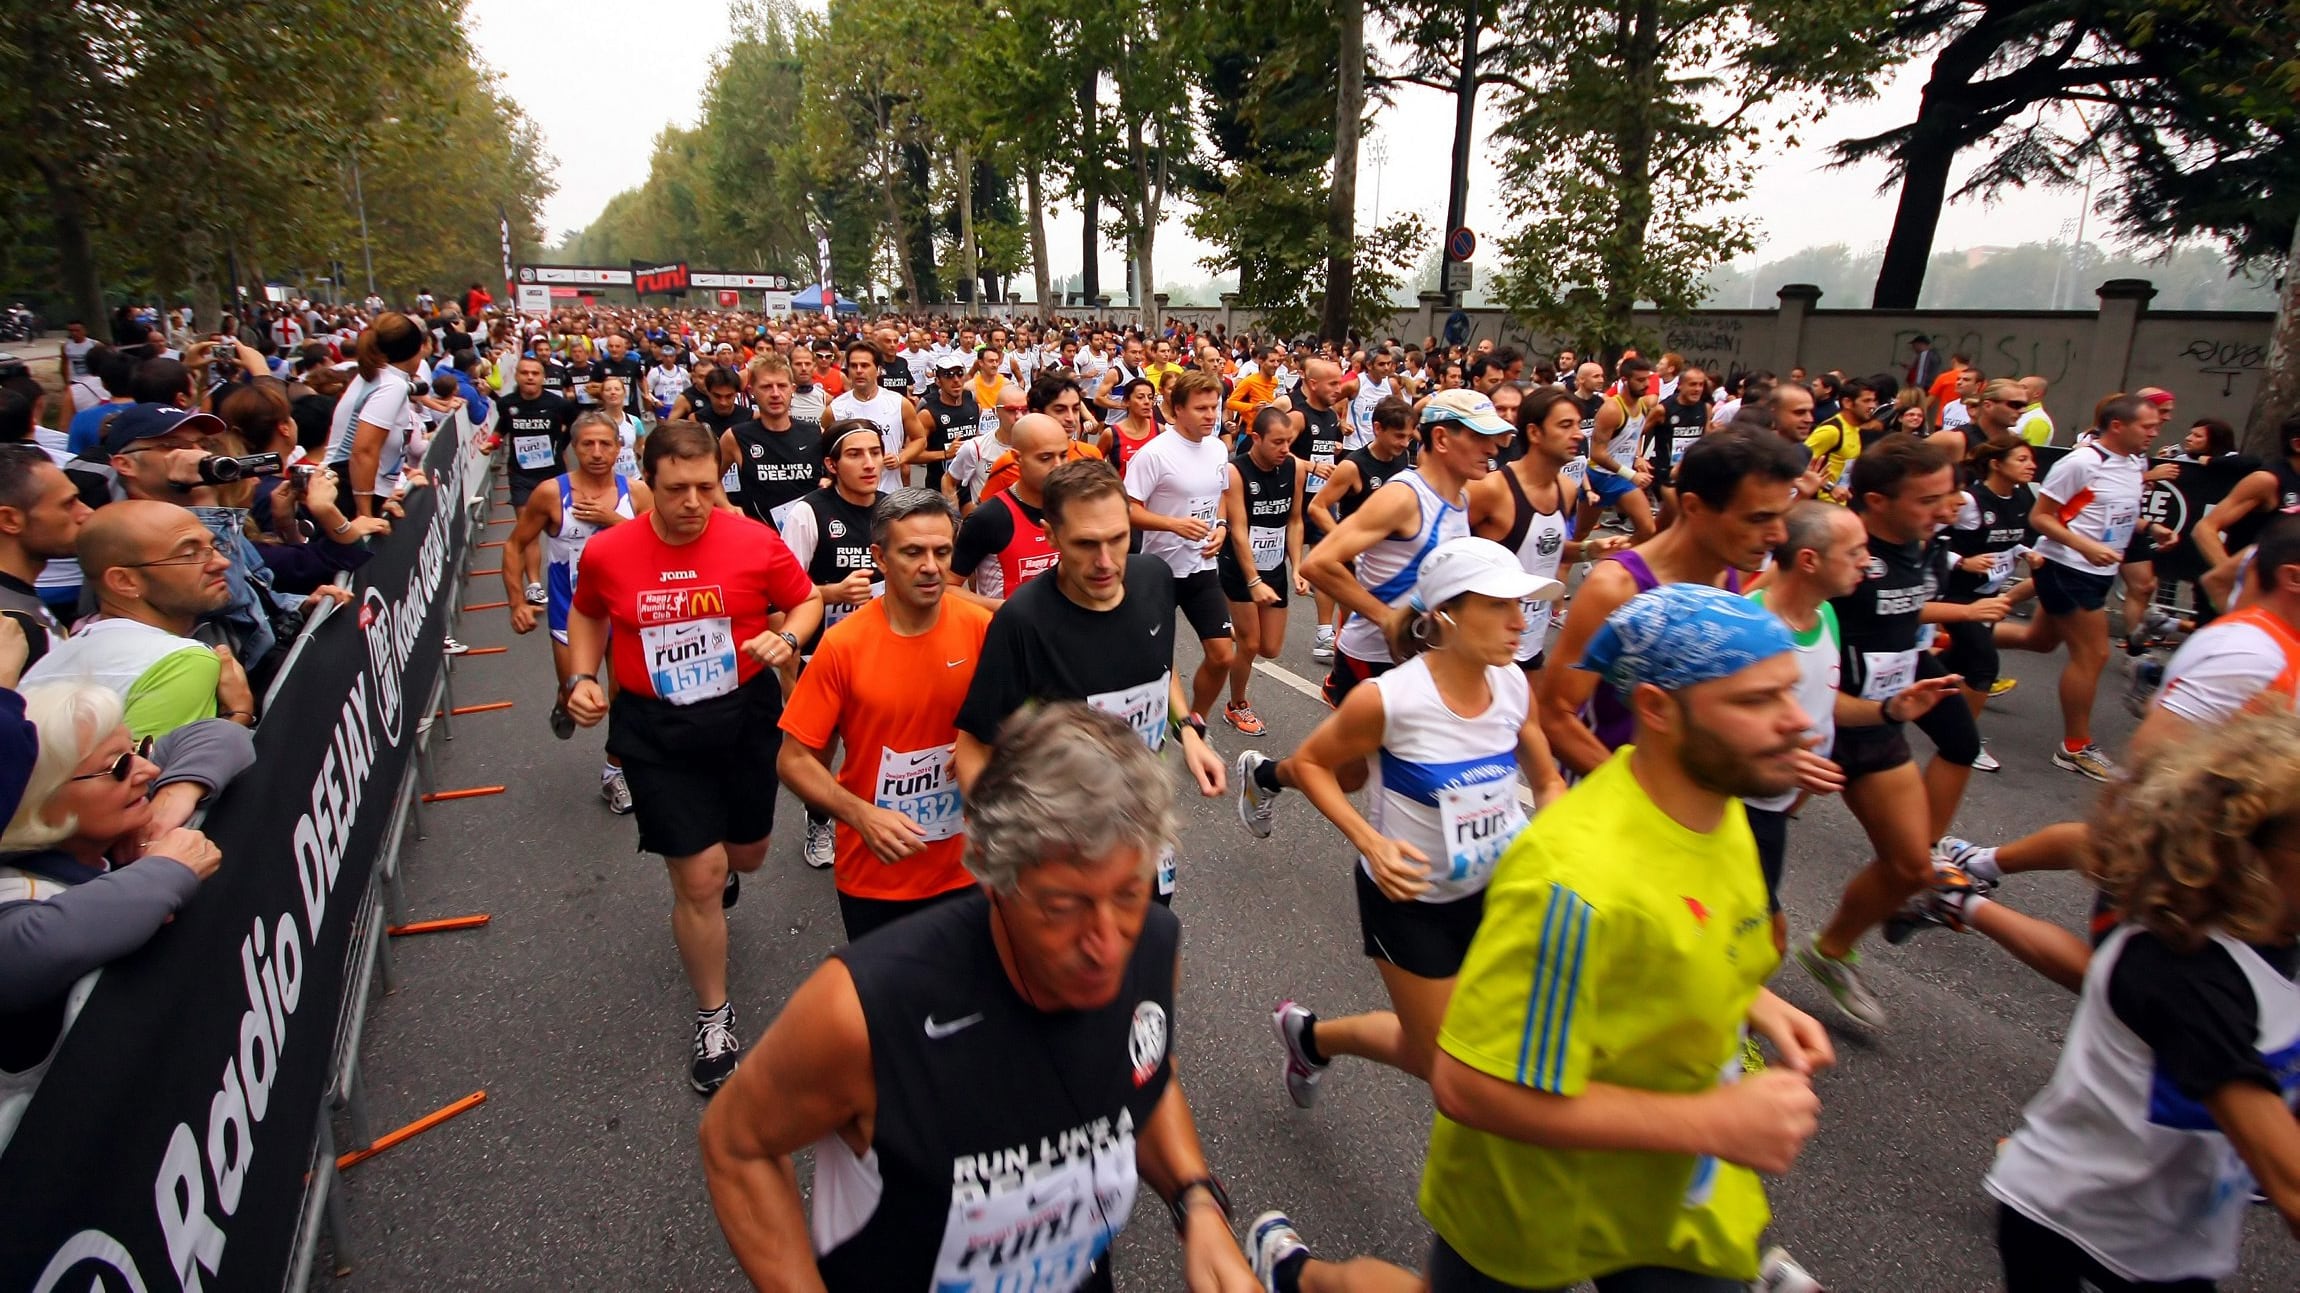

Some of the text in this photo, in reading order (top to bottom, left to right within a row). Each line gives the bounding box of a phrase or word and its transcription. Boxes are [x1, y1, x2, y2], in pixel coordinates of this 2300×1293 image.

[636, 261, 687, 294] run!
[513, 422, 551, 430] DEEJAY
[520, 442, 540, 453] run!
[758, 468, 813, 481] DEEJAY
[1252, 502, 1292, 516] DEEJAY
[836, 547, 862, 555] RUN
[1253, 536, 1279, 549] run!
[836, 554, 878, 568] DEE
[393, 566, 427, 673] Radio
[655, 634, 707, 667] run!
[665, 659, 726, 693] 1575
[1129, 701, 1151, 727] n!
[883, 764, 941, 797] run!
[293, 670, 373, 946] DEEJAY
[155, 915, 303, 1293] Radio
[953, 1143, 1028, 1185] RUN
[1040, 1115, 1112, 1161] LIKE
